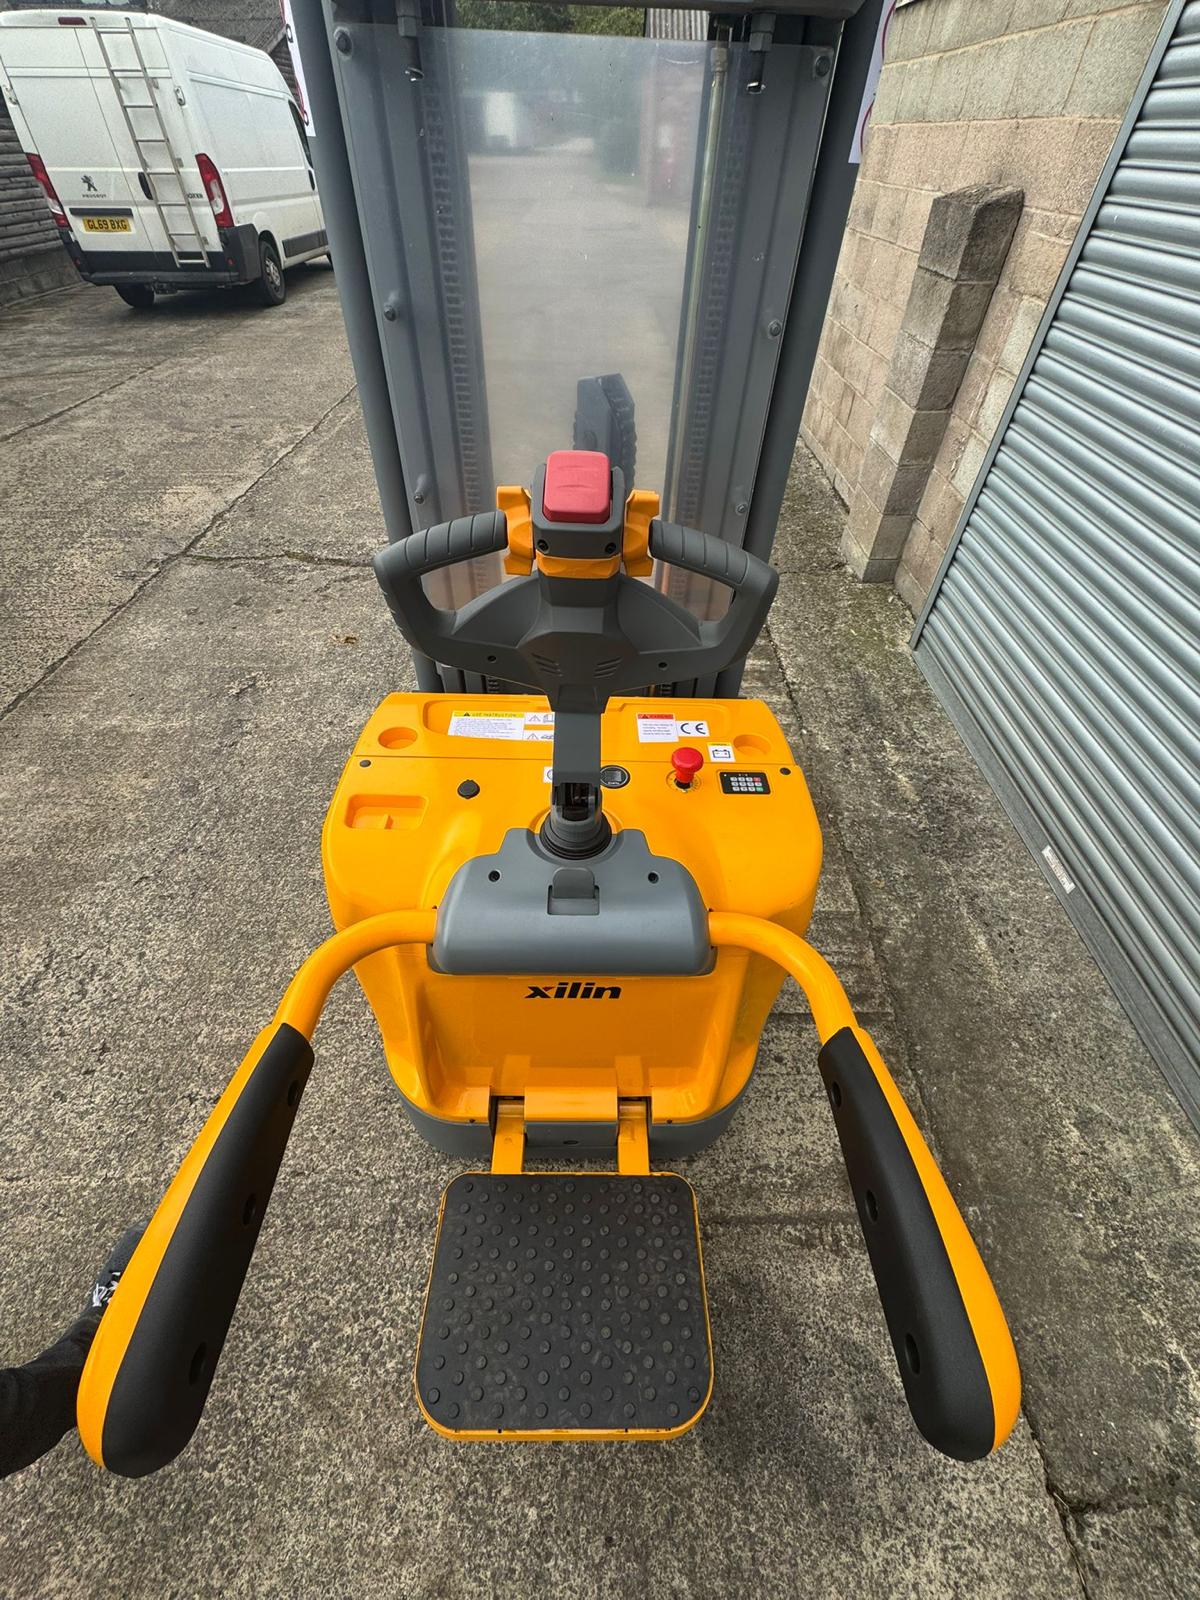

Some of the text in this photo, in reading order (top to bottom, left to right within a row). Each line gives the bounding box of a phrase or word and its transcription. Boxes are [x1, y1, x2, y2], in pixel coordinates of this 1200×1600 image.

[87, 219, 128, 230] GL69 BXG
[680, 722, 706, 735] CE
[524, 982, 622, 999] xilin
